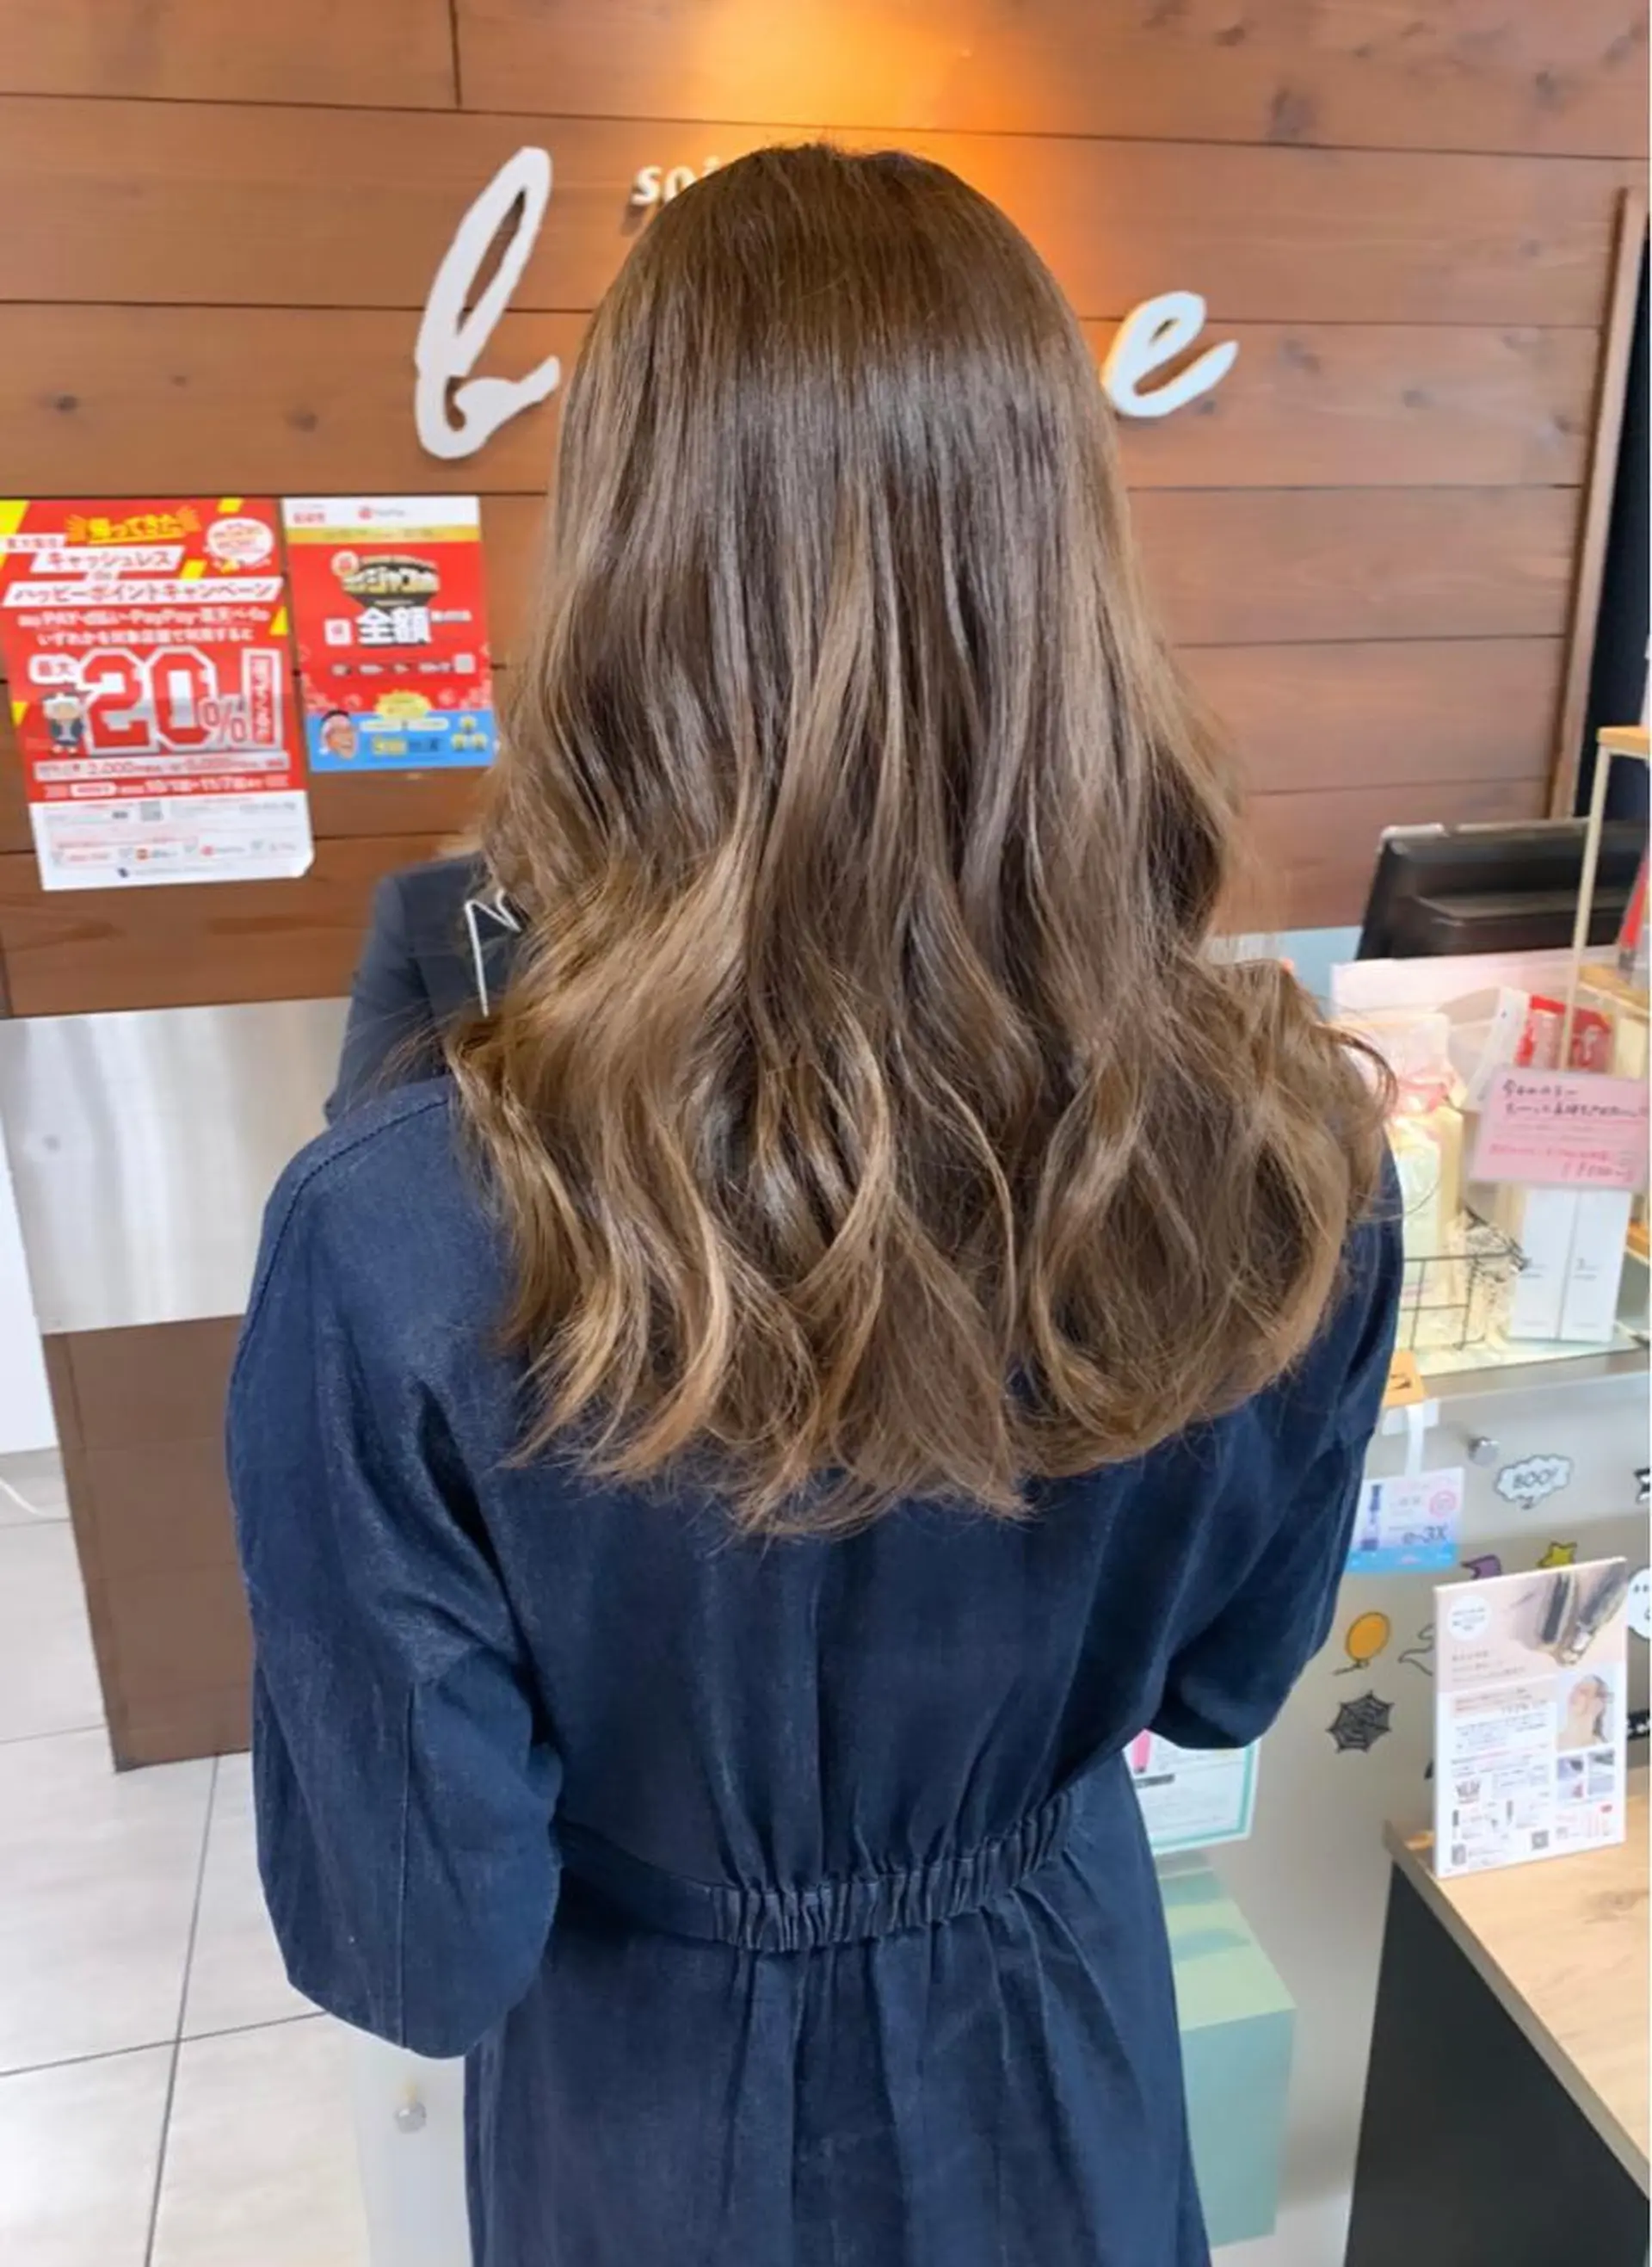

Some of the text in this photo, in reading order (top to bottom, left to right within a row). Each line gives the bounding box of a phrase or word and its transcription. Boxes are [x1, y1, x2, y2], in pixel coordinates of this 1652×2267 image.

[47, 550, 173, 571] キャッシュレス
